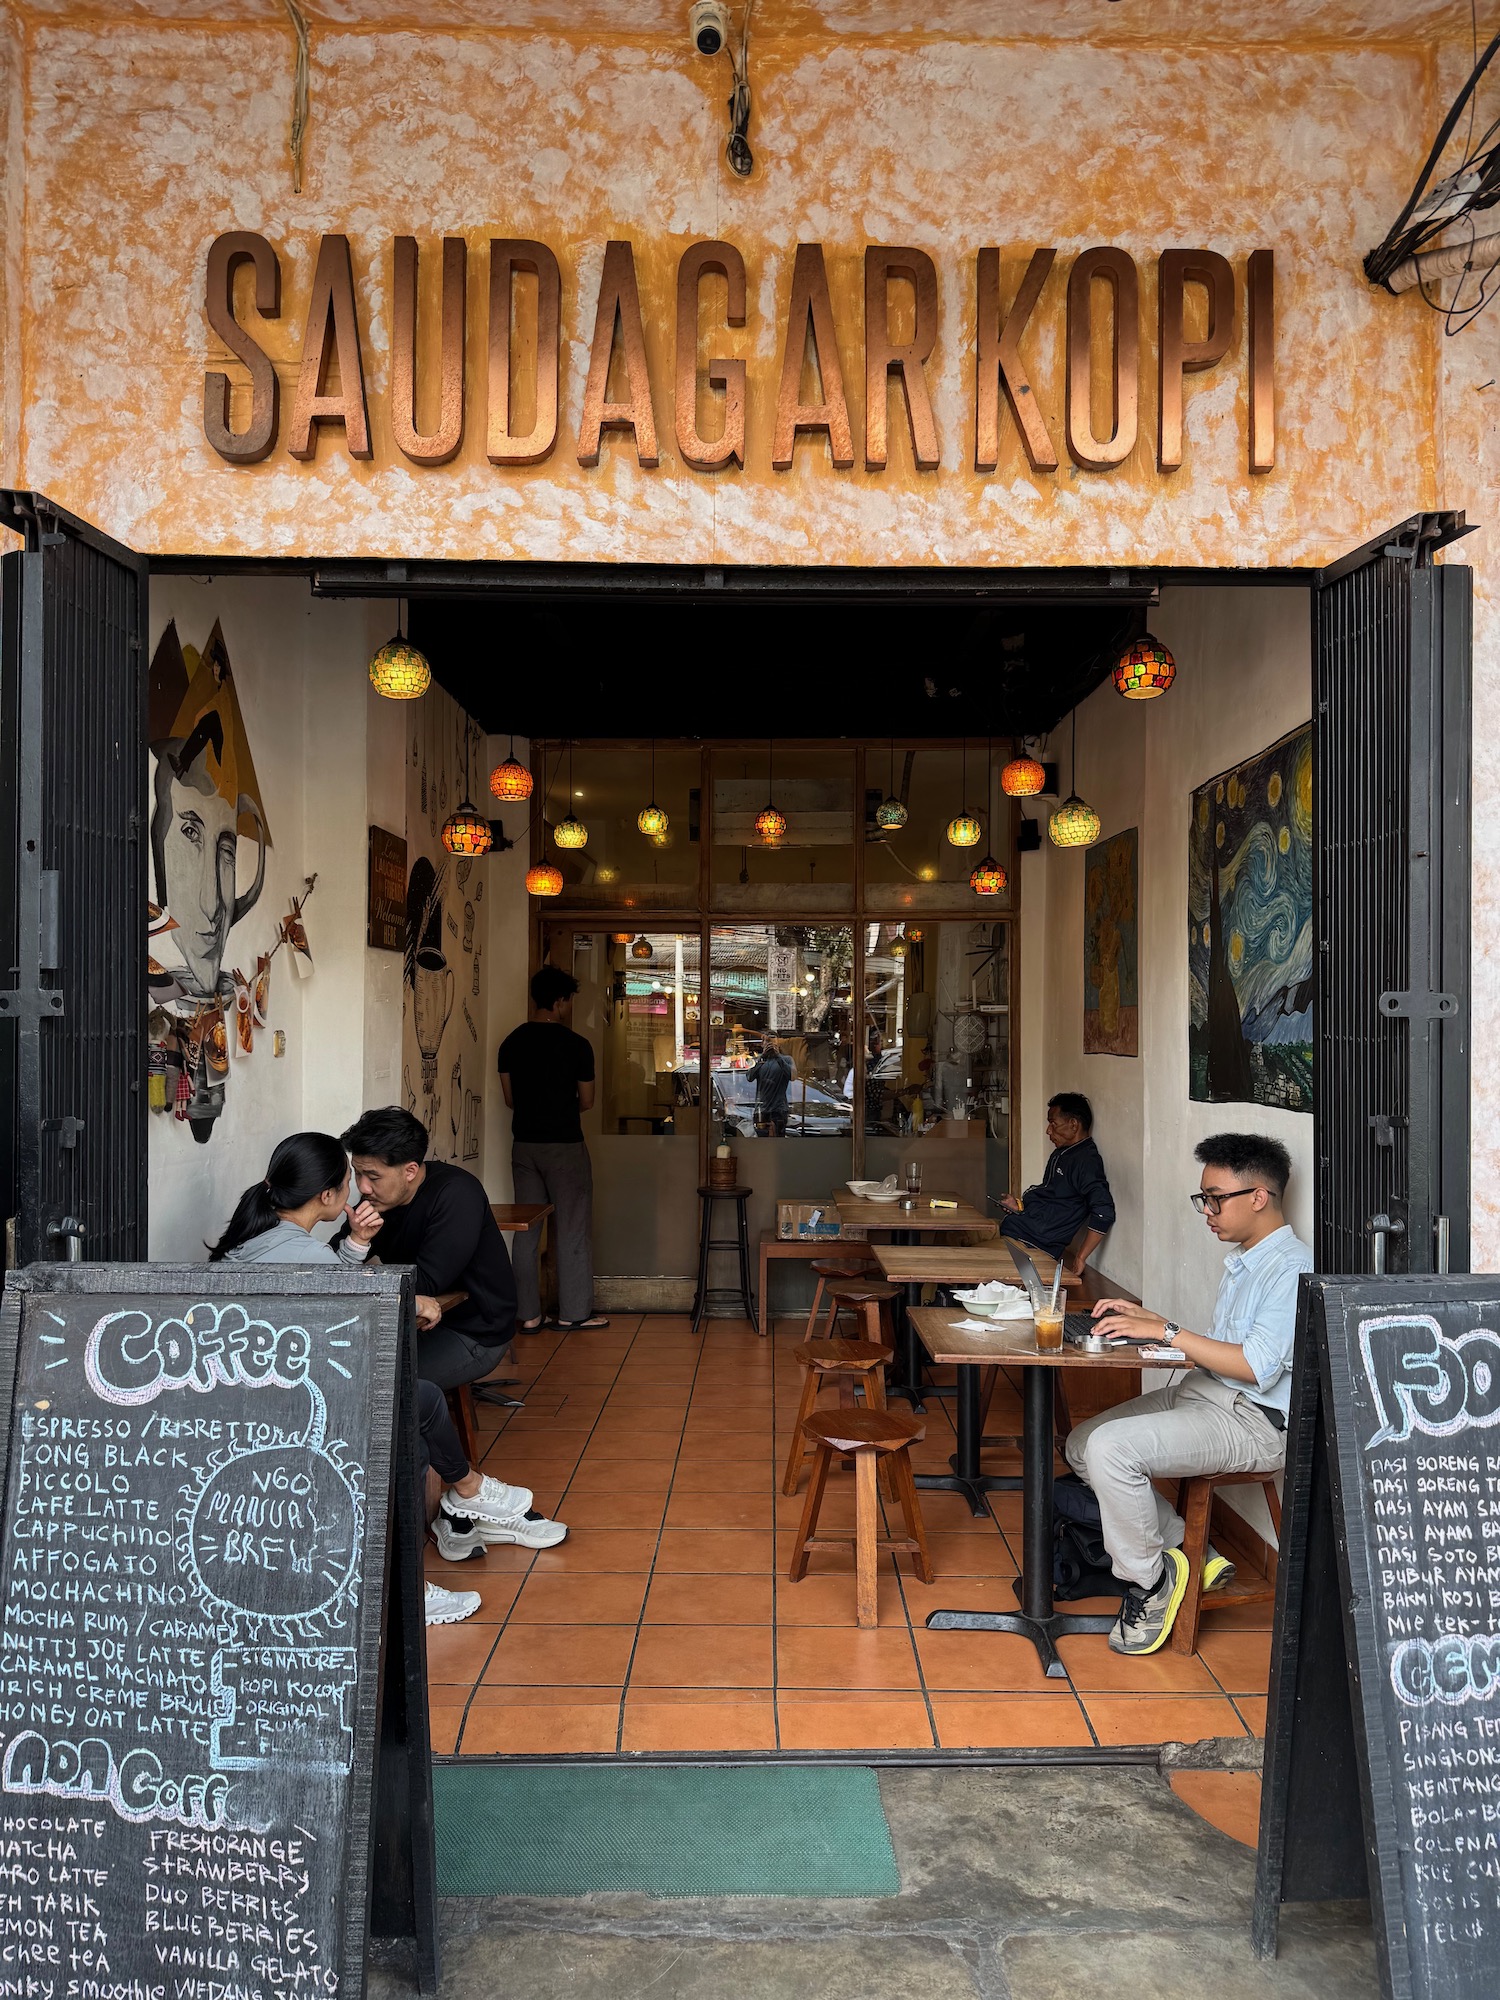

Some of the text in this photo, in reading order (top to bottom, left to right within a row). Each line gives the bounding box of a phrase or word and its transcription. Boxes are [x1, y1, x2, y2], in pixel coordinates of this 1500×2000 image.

[203, 230, 1276, 476] SAUDAGAR KOPI
[85, 1302, 311, 1406] Coffee
[1358, 1314, 1500, 1441] FOO
[21, 1416, 131, 1440] ESPRESSO
[19, 1443, 189, 1469] LONG BLACK
[20, 1471, 130, 1494] PICCOLO
[16, 1495, 159, 1520] CAFE LATTE
[204, 1490, 335, 1533] MANUAL
[1422, 1499, 1469, 1519] AYAM
[1424, 1524, 1473, 1546] AYAM
[13, 1548, 157, 1575] AFFOGATO
[224, 1529, 318, 1573] BREW
[1428, 1547, 1478, 1564] SOTO
[10, 1579, 187, 1605] MOCHACHINO
[5, 1603, 75, 1630] MOCHA
[84, 1611, 129, 1637] RUM
[3, 1631, 205, 1668] NUTTY JOE LATTE
[241, 1650, 346, 1671] SIGNATURE
[1, 1654, 99, 1682] CARAMEL
[0, 1679, 63, 1700] IRISH
[75, 1683, 149, 1709] CREME
[240, 1677, 278, 1696] KOPI
[245, 1699, 330, 1718] ORIGINAL
[84, 1707, 126, 1729] OAT
[137, 1715, 209, 1745] LATTE
[1399, 1719, 1468, 1746] PISANG
[0, 1815, 107, 1838] HOCOLATE
[0, 1861, 109, 1887] ARO LATTE
[31, 1892, 101, 1918] TARIK
[66, 1920, 108, 1947] TEA
[251, 1954, 340, 1994] GELATO
